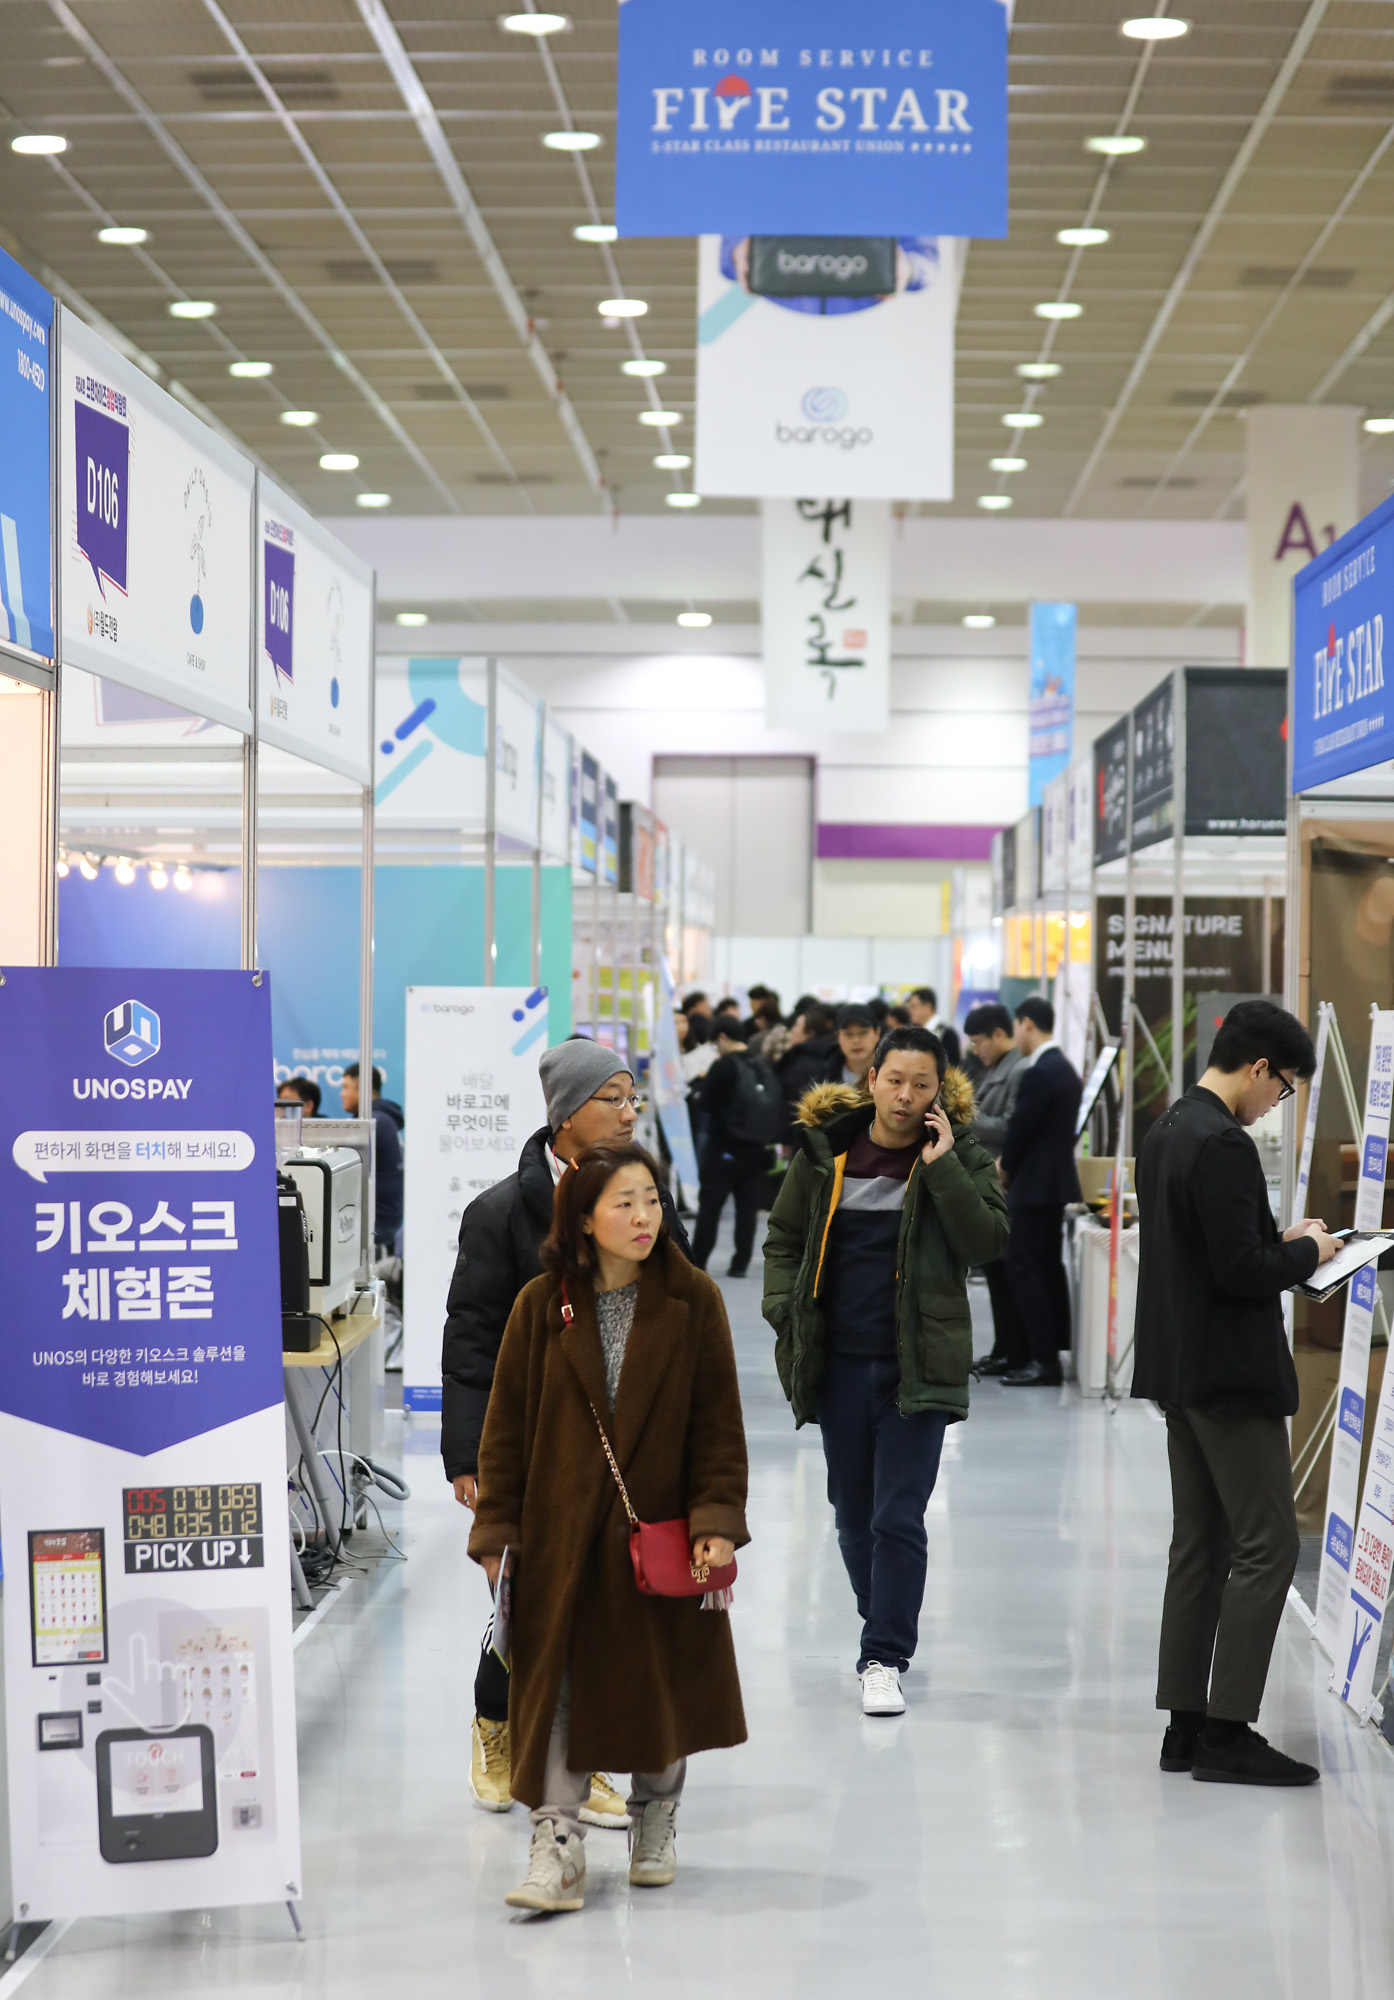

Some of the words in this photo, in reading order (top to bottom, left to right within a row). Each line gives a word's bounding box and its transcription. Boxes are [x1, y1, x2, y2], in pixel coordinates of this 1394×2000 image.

[692, 48, 779, 67] ROOM
[799, 48, 933, 67] SERVICE
[652, 86, 790, 131] FIVE
[815, 86, 973, 133] STAR
[704, 138, 750, 152] CLASS
[755, 139, 851, 153] RESTAURANT
[855, 139, 904, 152] UNION
[777, 248, 869, 282] barogo
[775, 419, 874, 451] barogo
[87, 455, 119, 529] D106
[270, 579, 289, 634] D106
[1346, 613, 1384, 704] STAR
[433, 1003, 475, 1015] barogo
[73, 1078, 193, 1100] UNOSPAY
[463, 1073, 494, 1090] 배달
[447, 1094, 510, 1111] 바로고에
[446, 1115, 510, 1132] 무엇이든
[34, 1142, 81, 1160] 편하게
[85, 1142, 132, 1160] 화면을
[136, 1141, 182, 1160] 터치해
[186, 1142, 237, 1159] 보세요!
[36, 1201, 239, 1254] 키오스크
[62, 1266, 214, 1321] 체험존
[33, 1349, 88, 1366] UNOS의
[91, 1348, 132, 1364] 다양한
[136, 1347, 189, 1363] 키오스크
[192, 1345, 246, 1362] 솔루션을
[83, 1371, 110, 1387] 바로
[114, 1369, 199, 1387] 경험해보세요!
[128, 1488, 166, 1514] 005
[173, 1486, 212, 1512] 070
[218, 1484, 257, 1510] 069
[128, 1513, 167, 1539] 048
[174, 1511, 213, 1537] 035
[135, 1542, 194, 1571] PICK
[202, 1540, 237, 1567] UP
